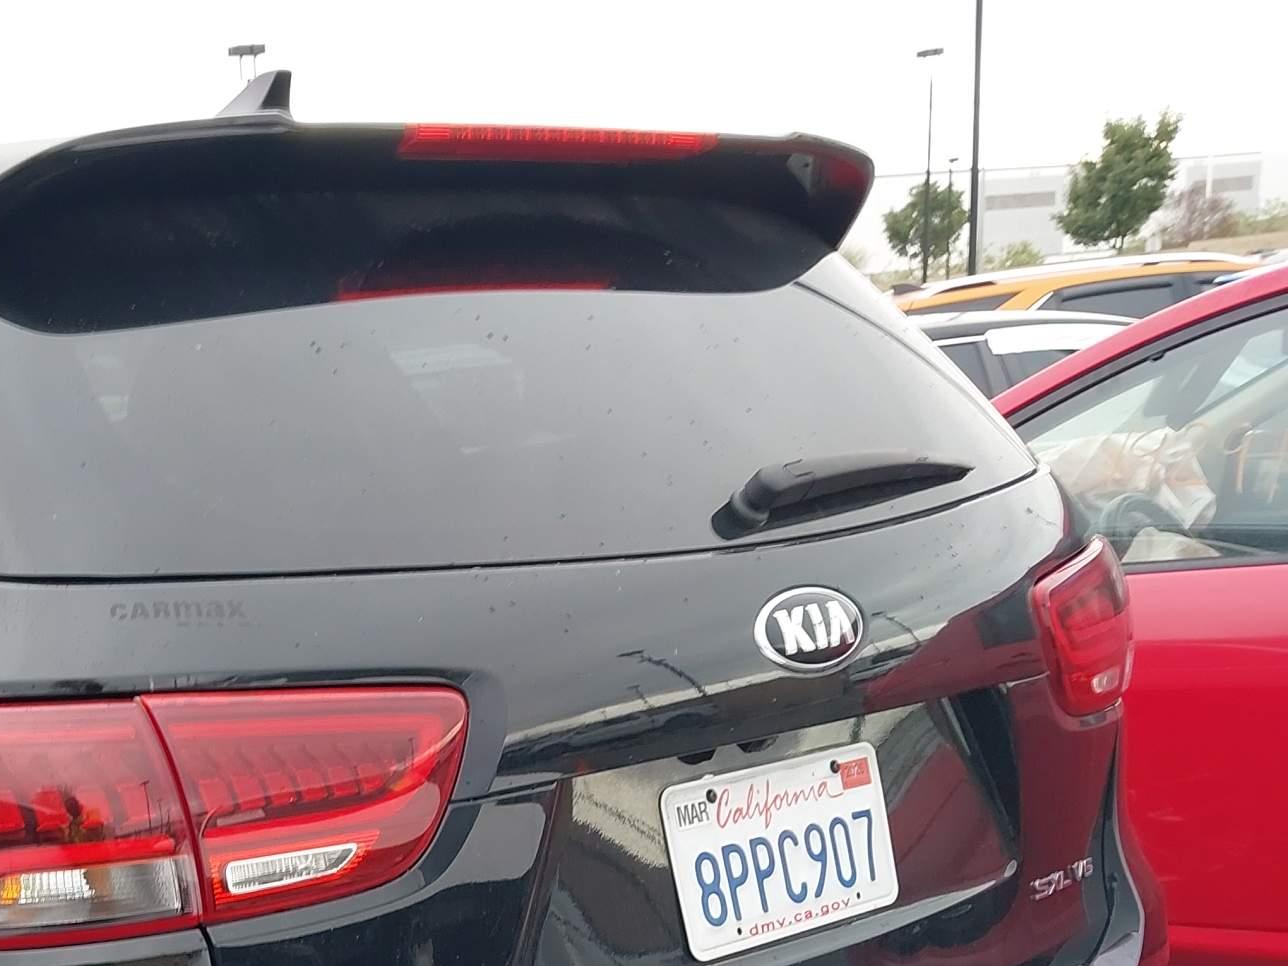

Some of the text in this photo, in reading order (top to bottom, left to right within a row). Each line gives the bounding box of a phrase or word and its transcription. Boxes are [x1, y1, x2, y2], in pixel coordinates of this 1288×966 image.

[773, 600, 855, 655] KIA
[676, 801, 709, 827] MAR
[716, 779, 843, 828] California
[695, 809, 876, 927] 8PPC907
[749, 898, 850, 936] dmv.ca.gov
